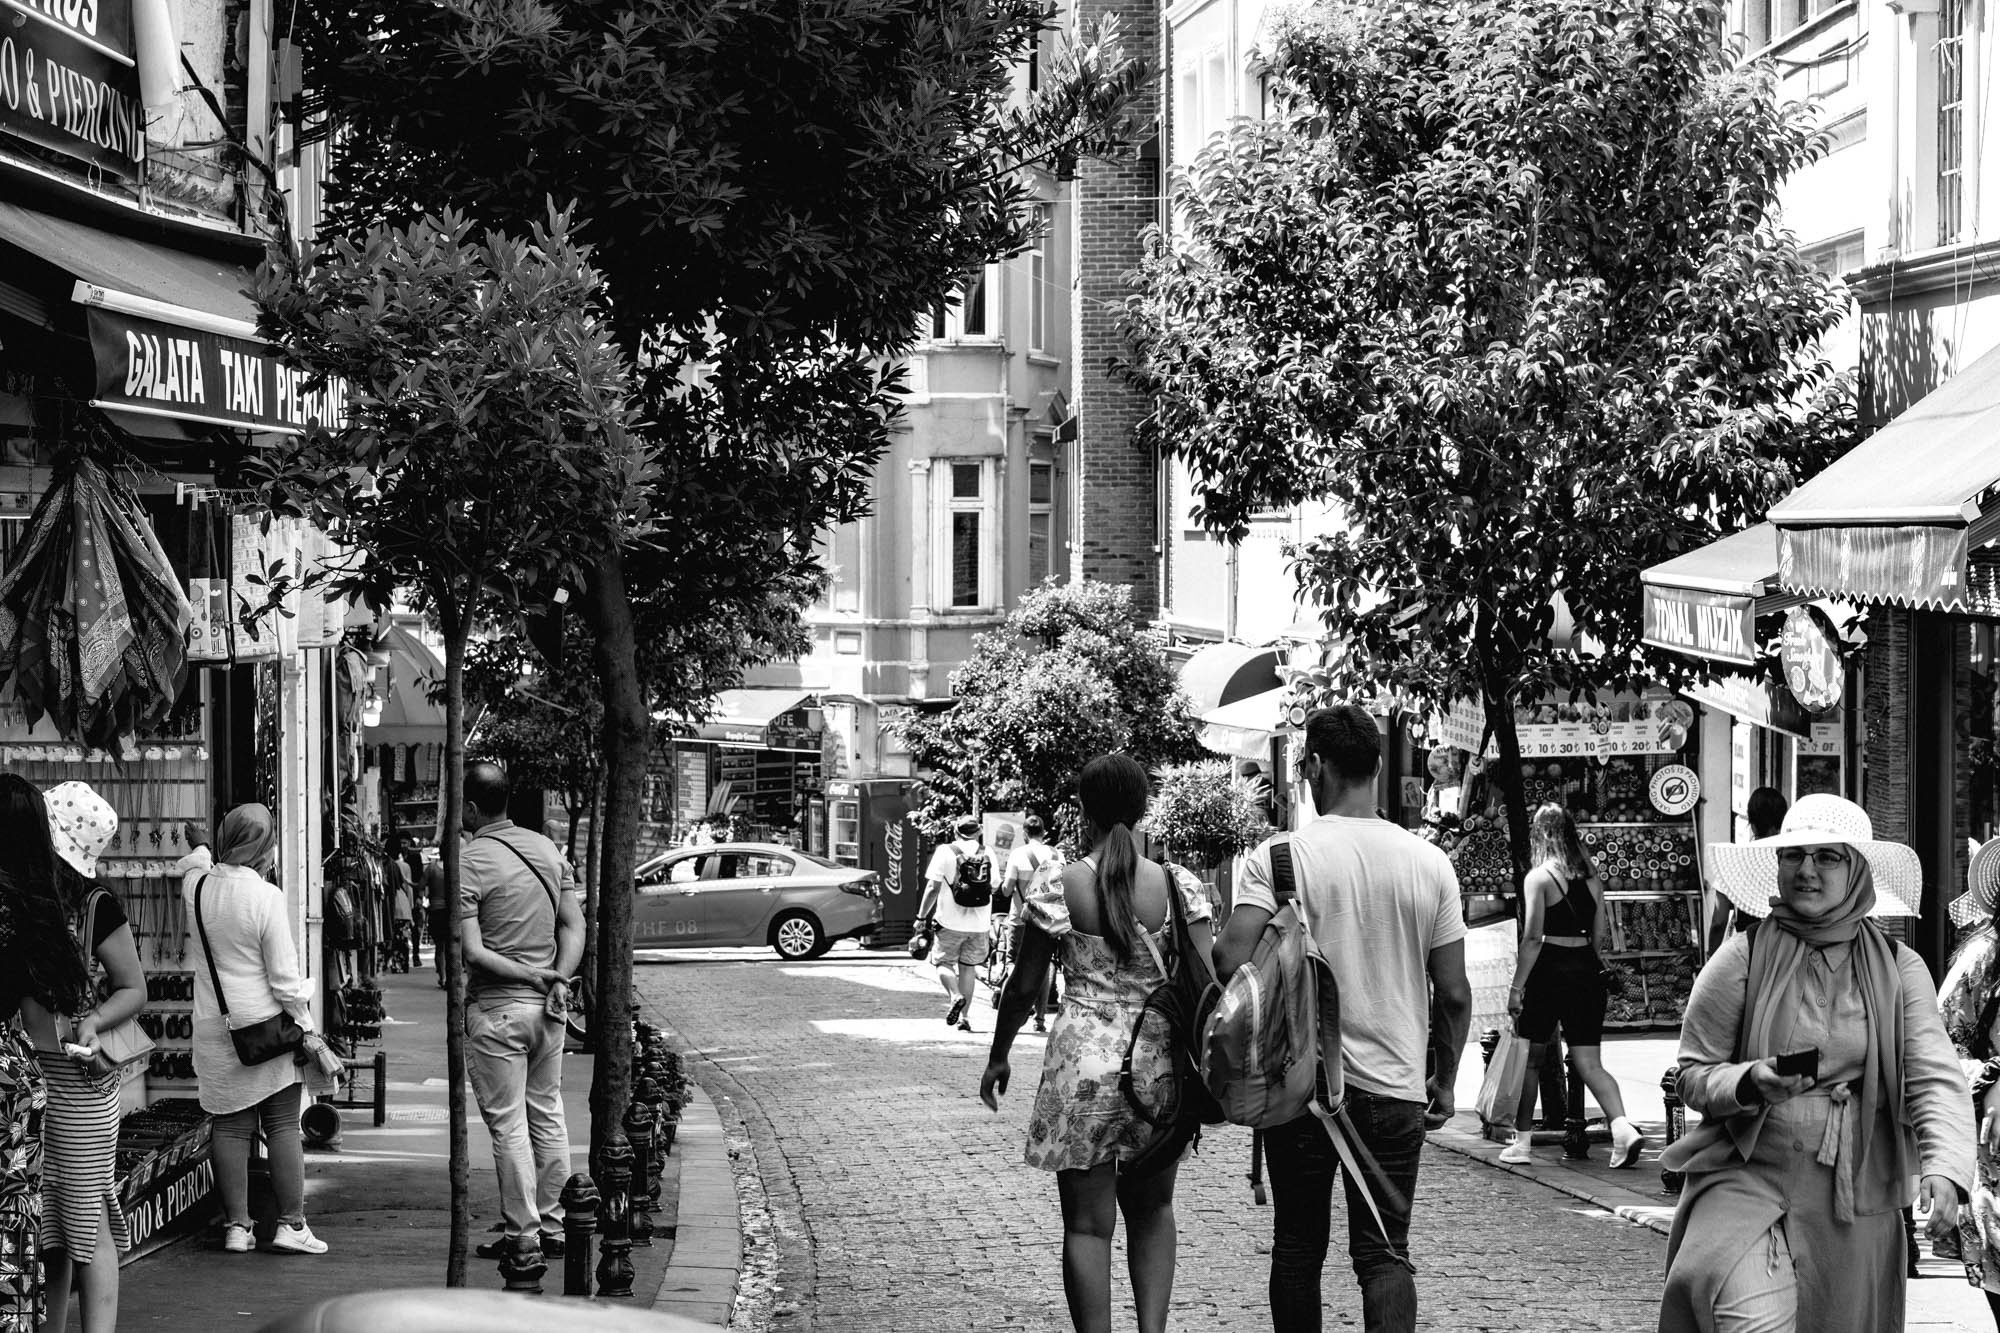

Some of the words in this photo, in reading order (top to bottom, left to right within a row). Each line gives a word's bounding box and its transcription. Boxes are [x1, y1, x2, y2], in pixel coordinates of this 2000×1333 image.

[0, 36, 19, 111] O
[26, 48, 44, 121] &
[46, 58, 146, 163] PIERCING
[125, 330, 205, 404] GALATA
[220, 349, 264, 417] TAKI
[1654, 598, 1694, 646] TONAL
[1539, 743, 1549, 754] 10
[1559, 743, 1573, 754] 30
[1584, 742, 1596, 752] 10
[1631, 741, 1645, 751] 20
[1650, 766, 1675, 789] PHOTOS
[1676, 766, 1685, 775] IS
[1650, 791, 1671, 813] TAKING
[675, 919, 698, 935] 08
[155, 1193, 165, 1231] &
